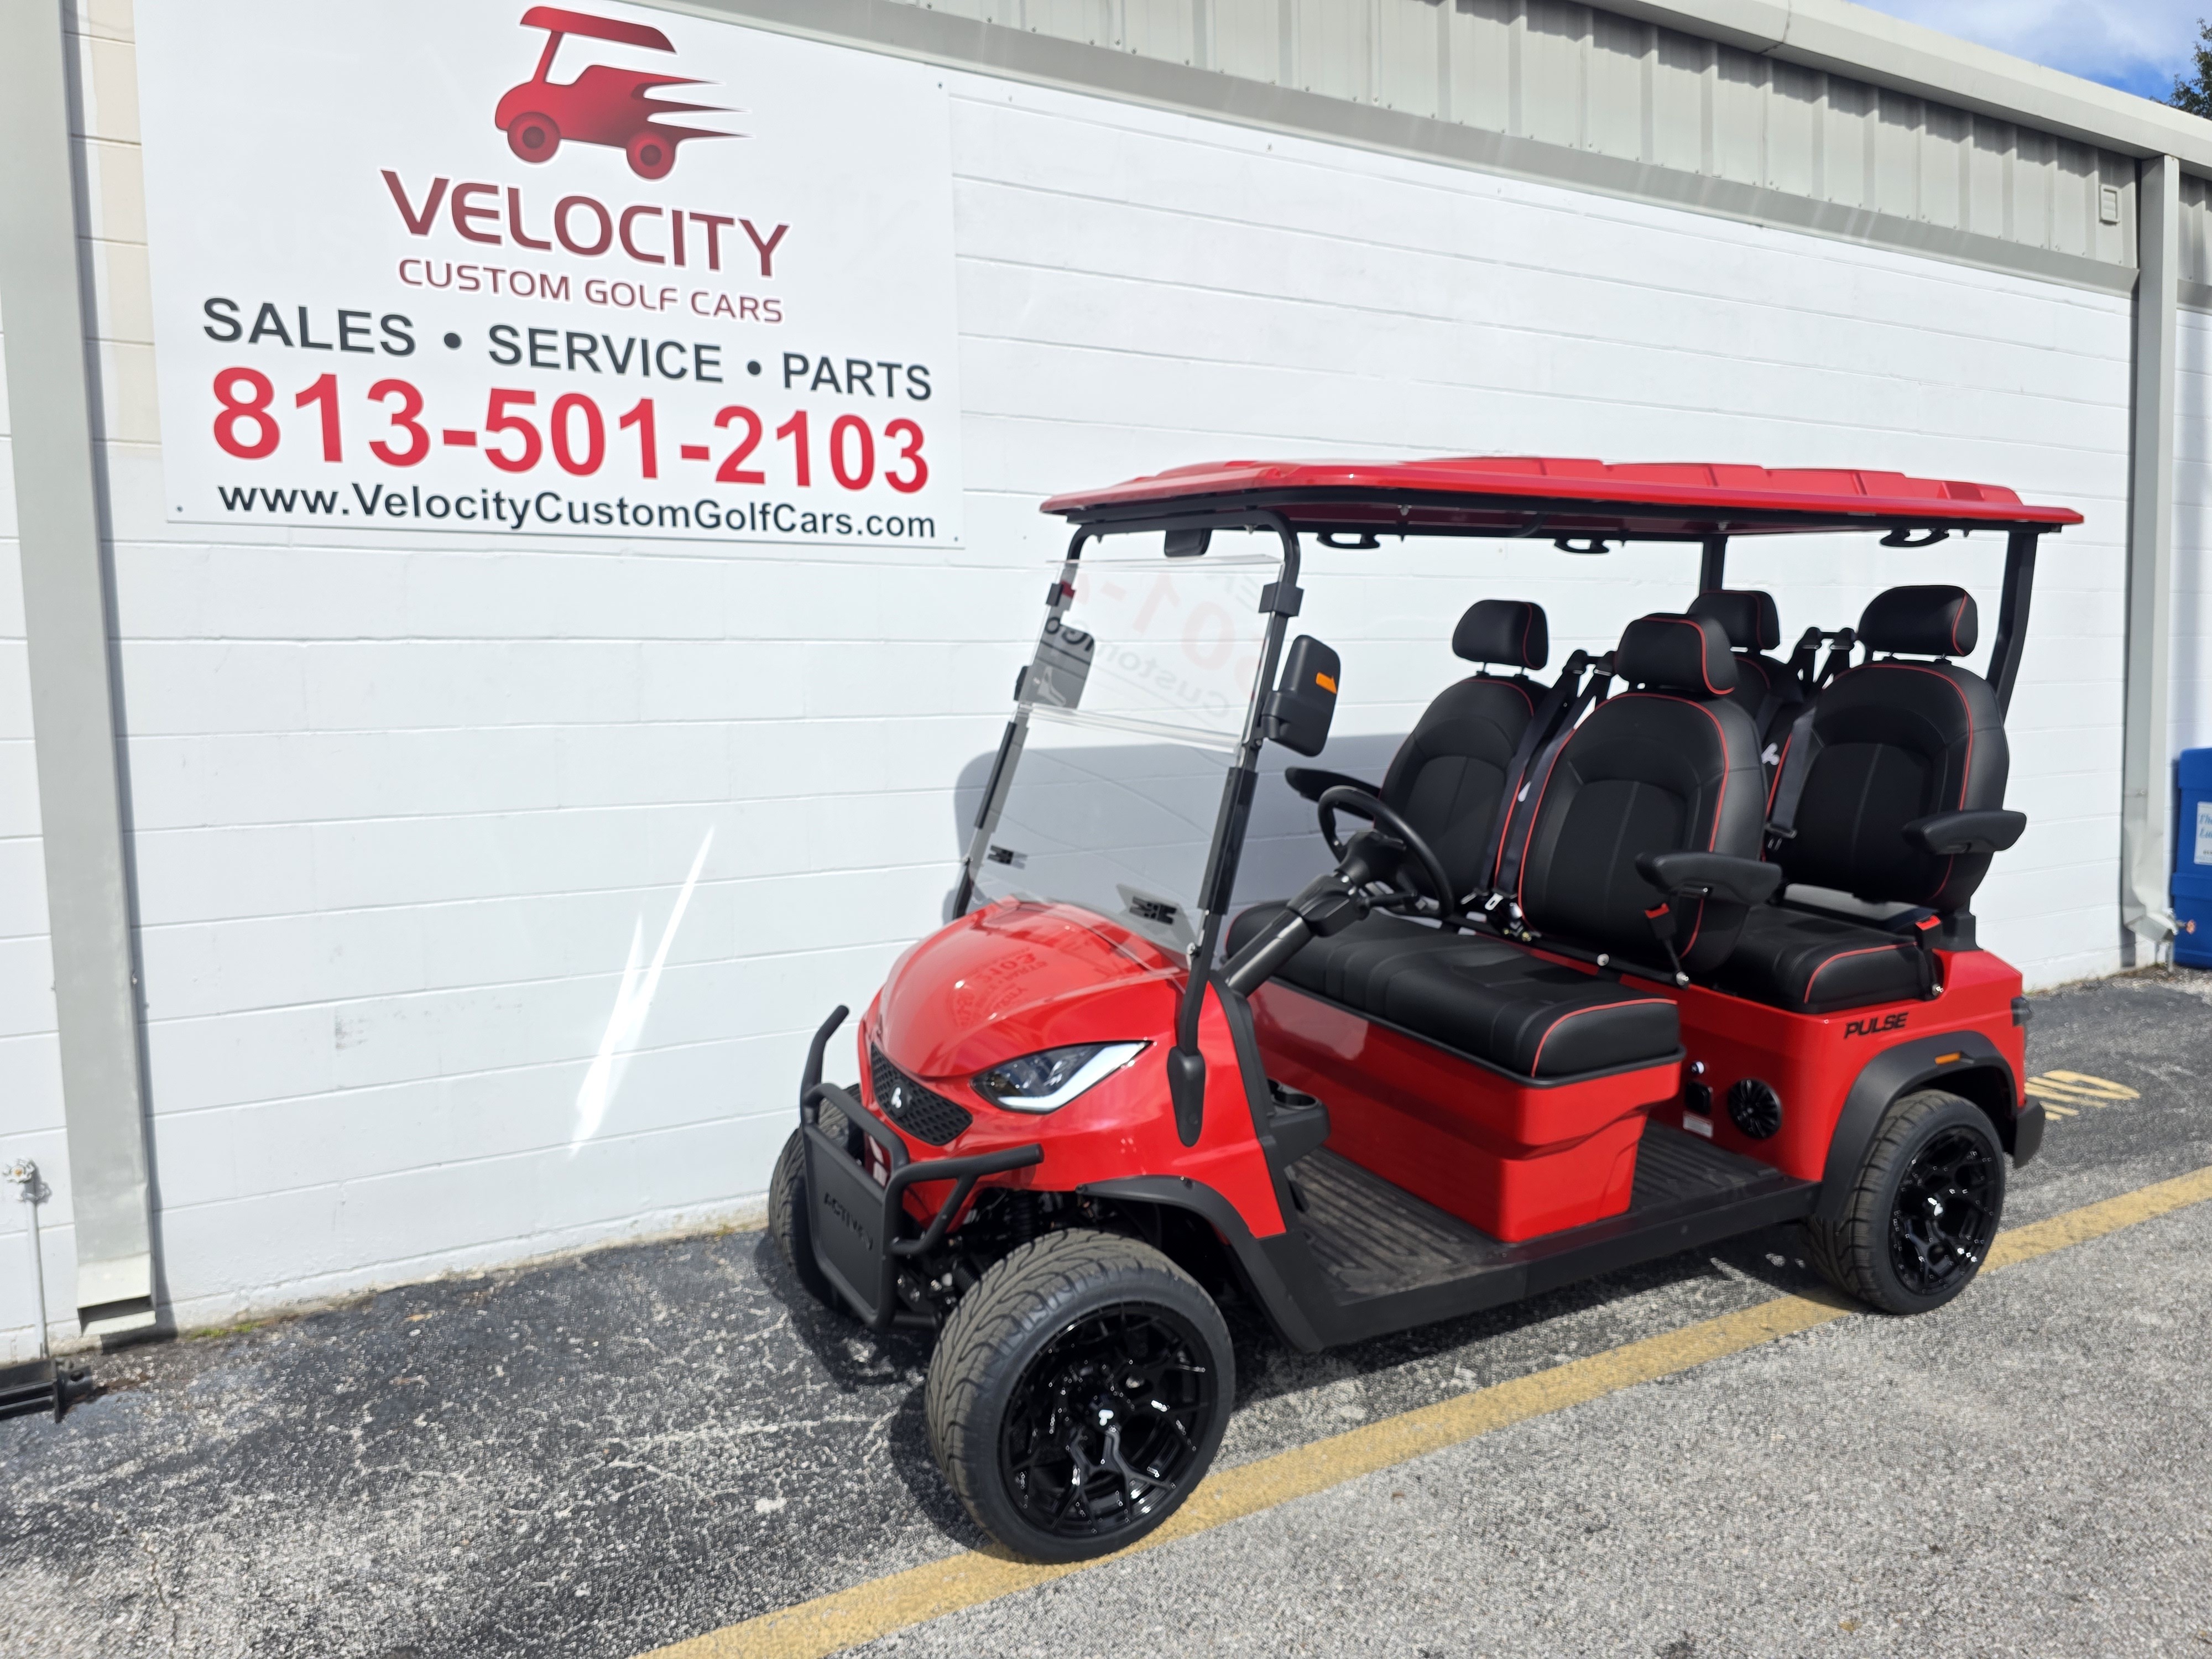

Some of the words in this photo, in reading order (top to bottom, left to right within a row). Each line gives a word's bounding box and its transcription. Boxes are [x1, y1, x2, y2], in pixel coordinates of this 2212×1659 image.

[380, 169, 789, 277] VELOCITY
[399, 259, 570, 300] CUSTOM
[585, 279, 677, 311] GOLF
[690, 291, 782, 323] CARS
[203, 297, 416, 357] SALES
[488, 324, 723, 384] SERVICE
[782, 352, 932, 401] PARTS
[213, 367, 928, 494] 813-501-2103
[217, 482, 935, 539] www.VelocityCustomGolfCars.com
[1843, 1011, 1909, 1039] PULSE
